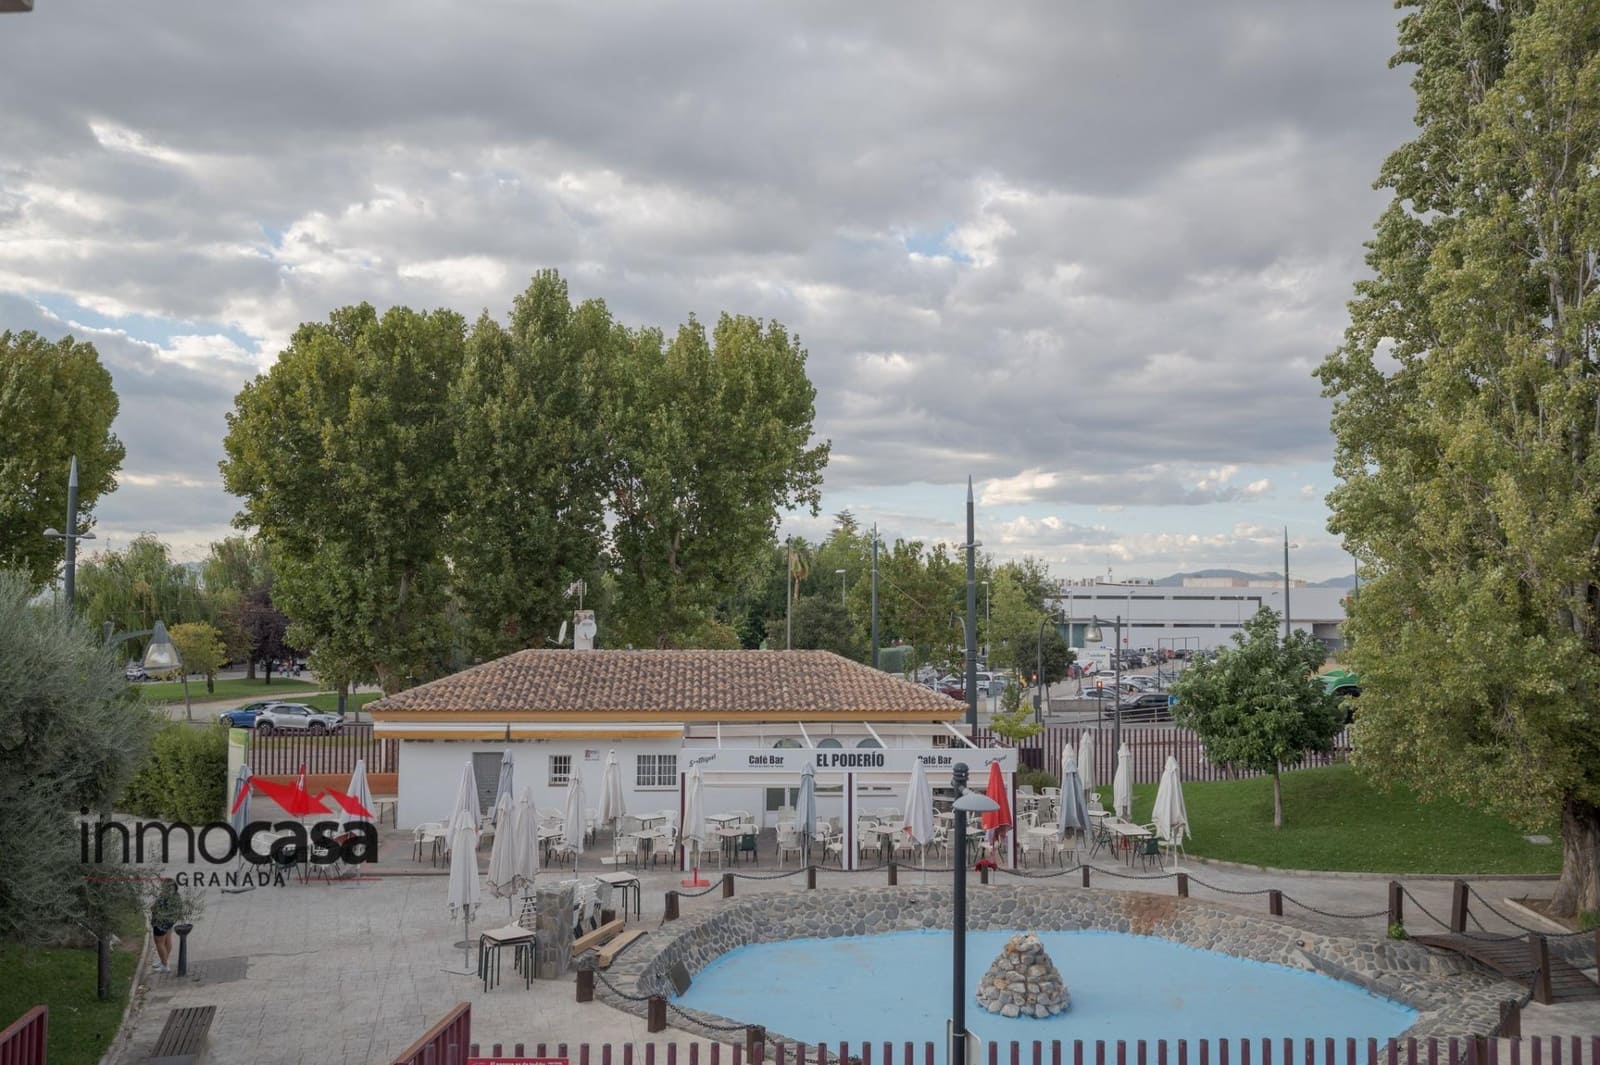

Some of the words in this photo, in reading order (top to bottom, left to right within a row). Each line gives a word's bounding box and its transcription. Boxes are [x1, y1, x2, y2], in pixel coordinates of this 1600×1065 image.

[749, 754, 768, 764] Café
[769, 755, 784, 764] Bar
[816, 753, 829, 767] EL
[832, 751, 884, 767] PODERÍO
[938, 755, 952, 764] Bar
